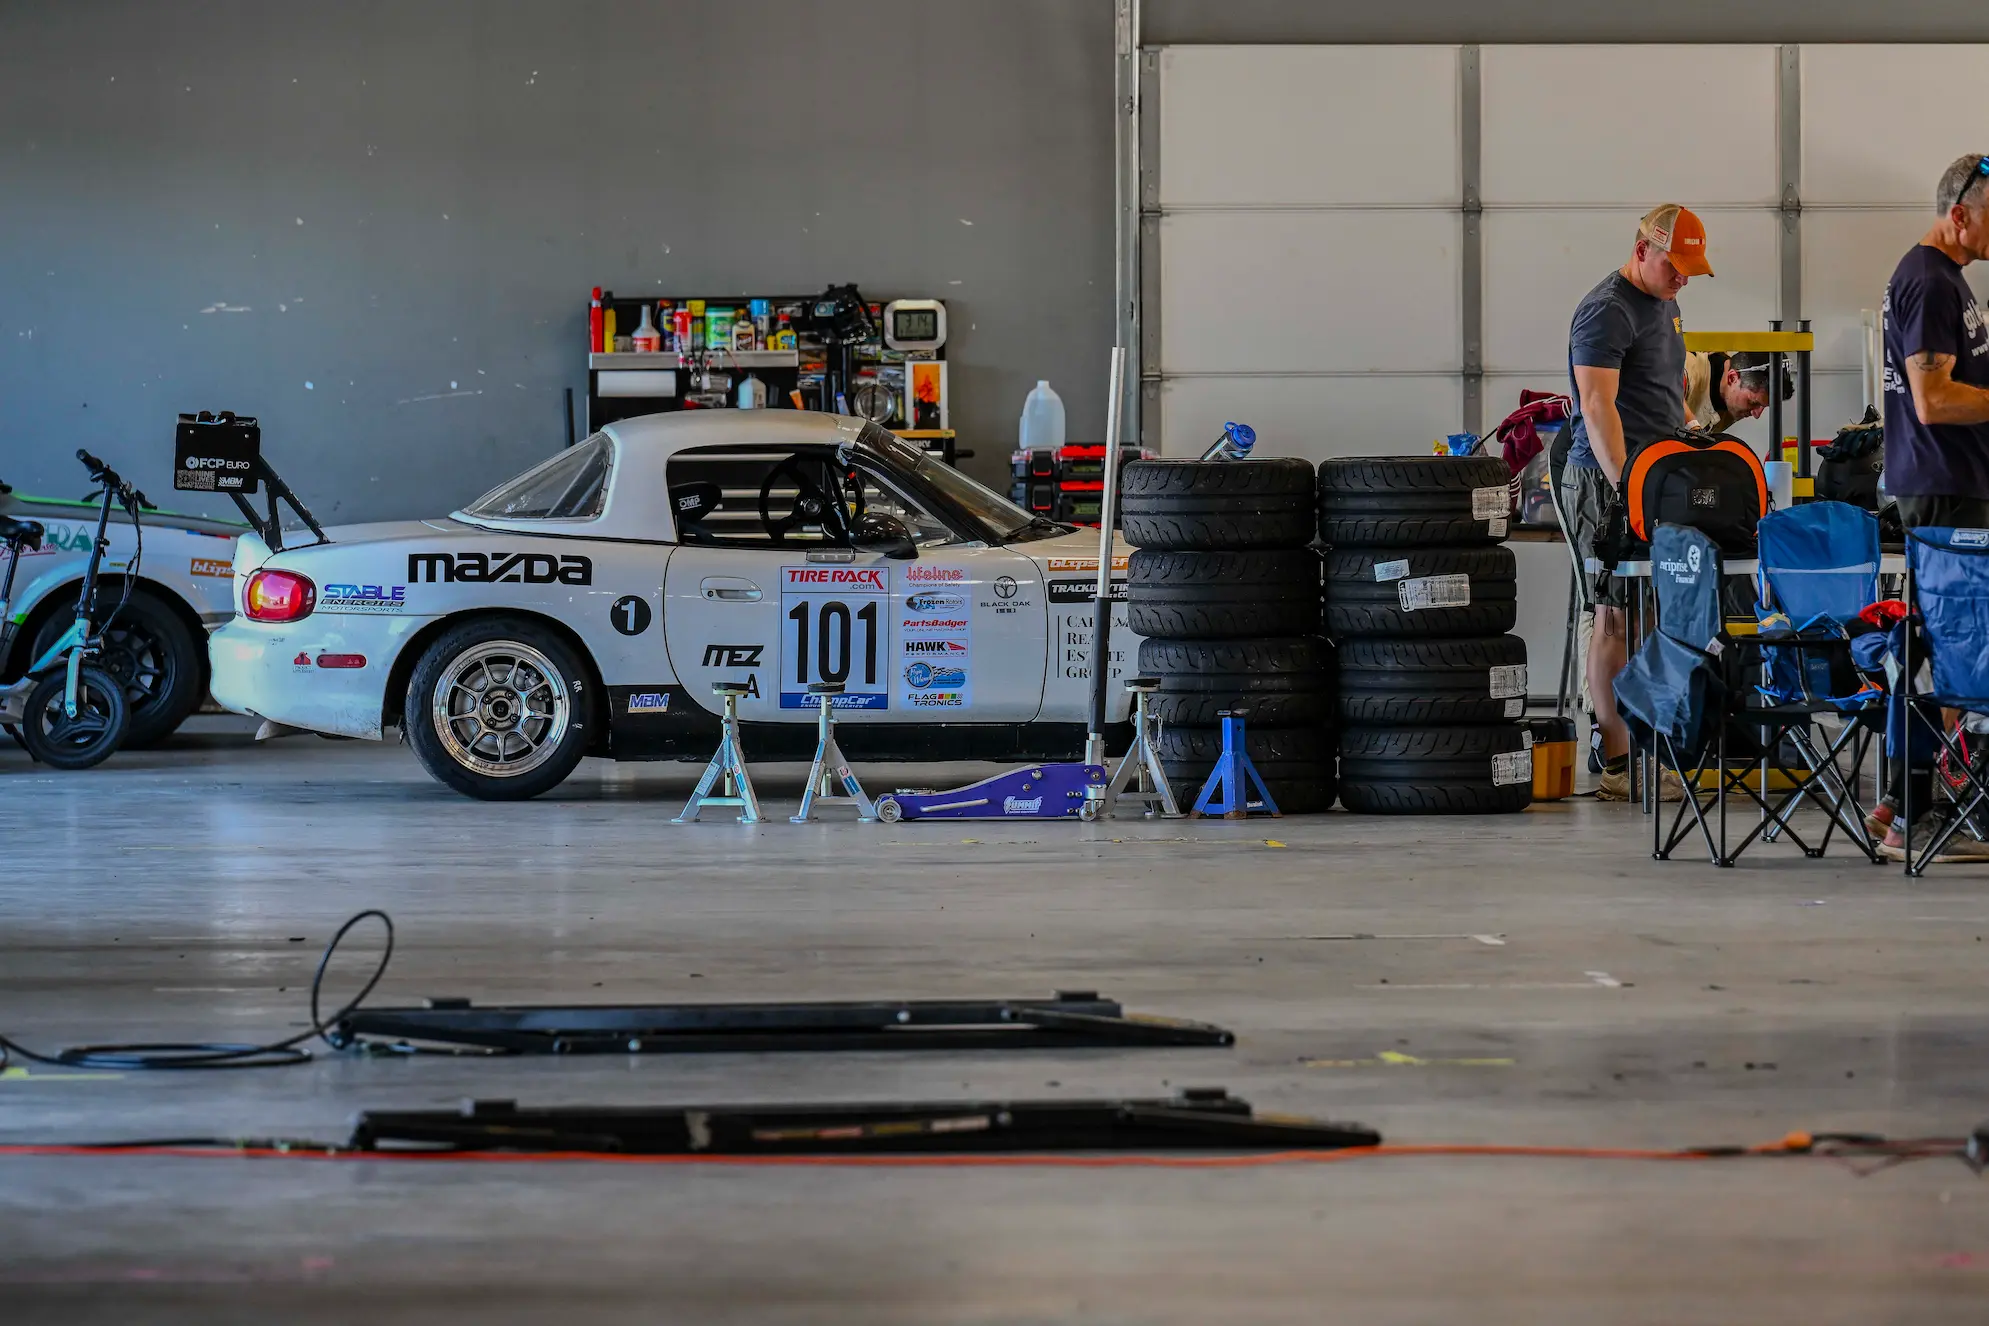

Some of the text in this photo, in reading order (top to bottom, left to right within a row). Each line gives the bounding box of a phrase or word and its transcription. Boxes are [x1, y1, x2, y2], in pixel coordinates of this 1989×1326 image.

[200, 458, 250, 470] FCP EURO
[680, 497, 700, 507] OMP
[788, 571, 884, 590] TIRE RACK
[324, 584, 406, 600] STABLE
[321, 599, 405, 607] ENERGIES
[321, 605, 403, 613] MOTORSPORTS
[903, 620, 968, 628] PartsBadger
[789, 601, 877, 685] 101
[906, 641, 946, 651] HAWK
[1066, 666, 1122, 679] GRP
[742, 673, 761, 699] A
[630, 694, 669, 708] MBM
[801, 695, 872, 705] ChmpCar
